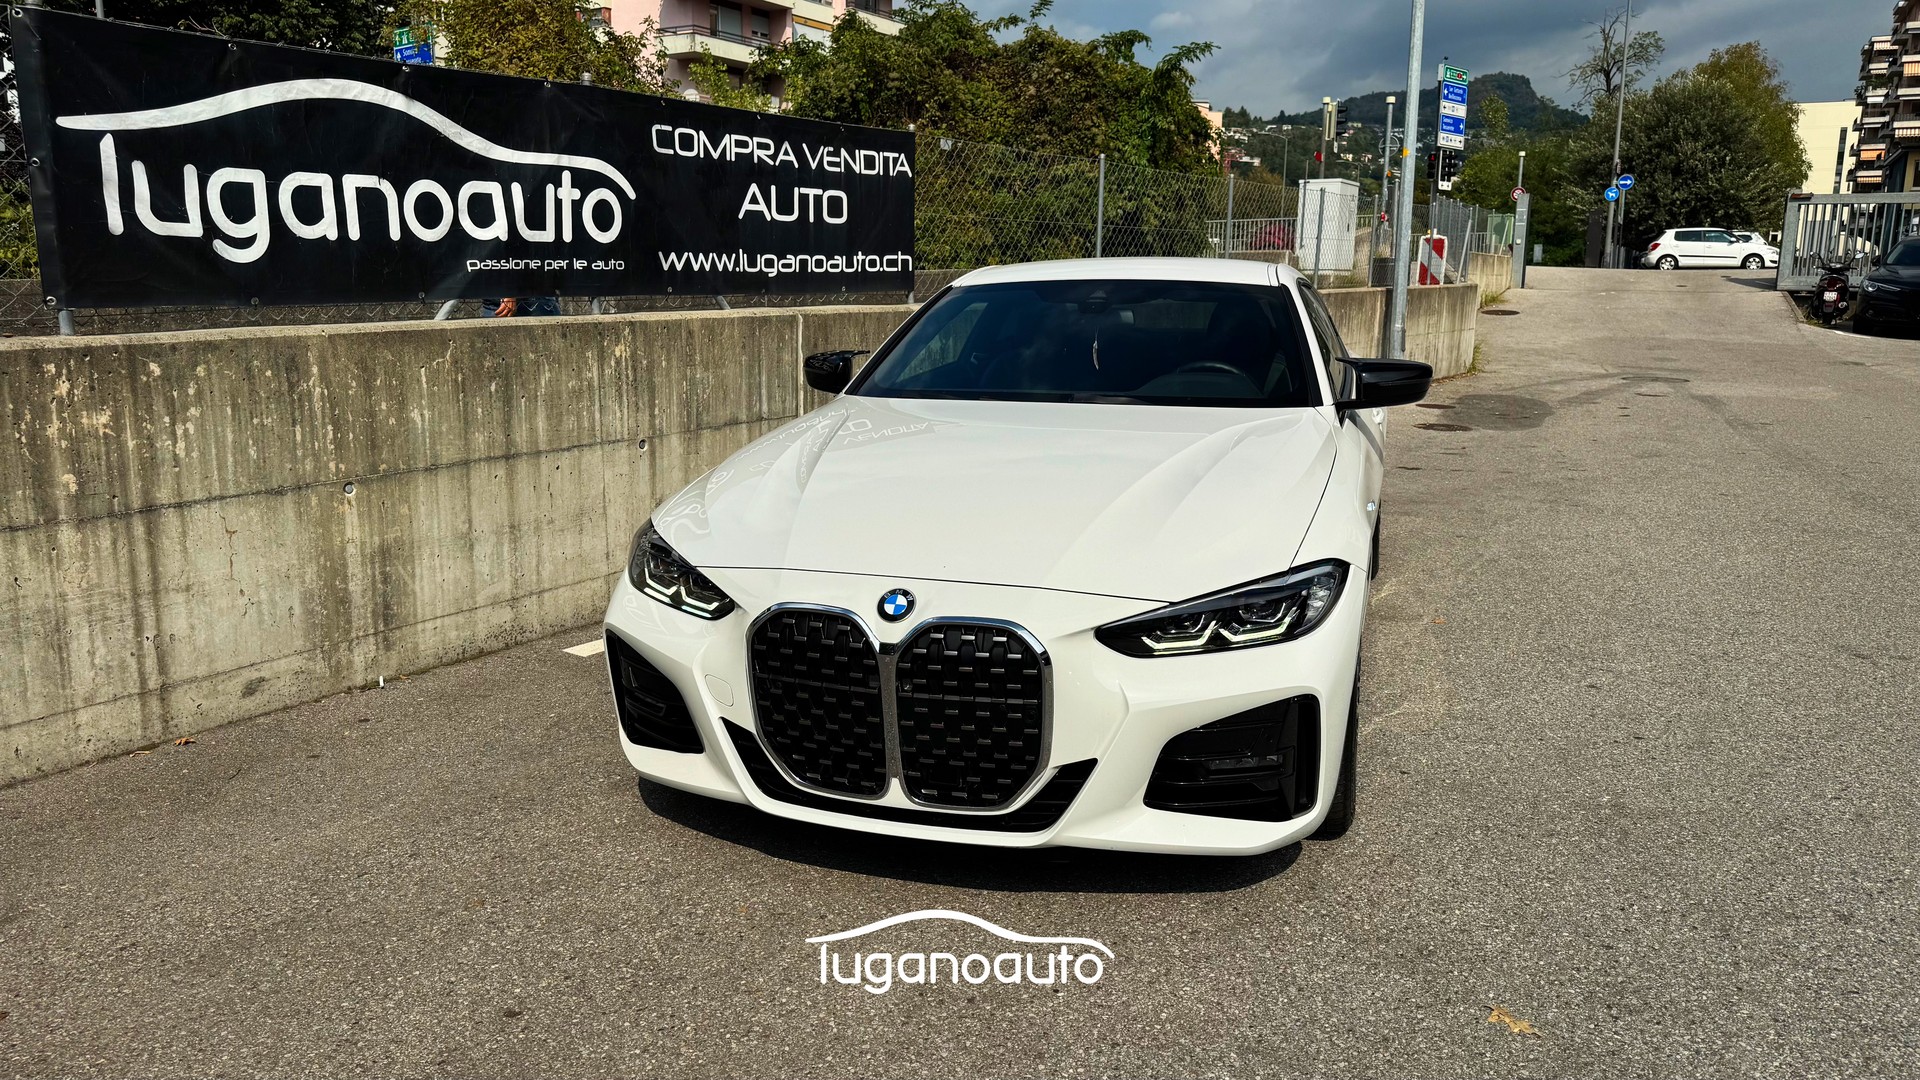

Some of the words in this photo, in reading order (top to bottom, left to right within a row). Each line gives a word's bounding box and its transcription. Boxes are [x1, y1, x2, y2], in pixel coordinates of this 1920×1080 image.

[651, 124, 799, 169] COMPRA
[801, 142, 913, 178] VENDITA
[99, 132, 623, 264] luganoauto
[737, 182, 848, 225] AUTO
[466, 257, 542, 272] passione
[544, 259, 570, 272] per
[573, 257, 588, 270] le
[591, 258, 625, 270] auto
[658, 248, 913, 278] www.luganoauto.ch
